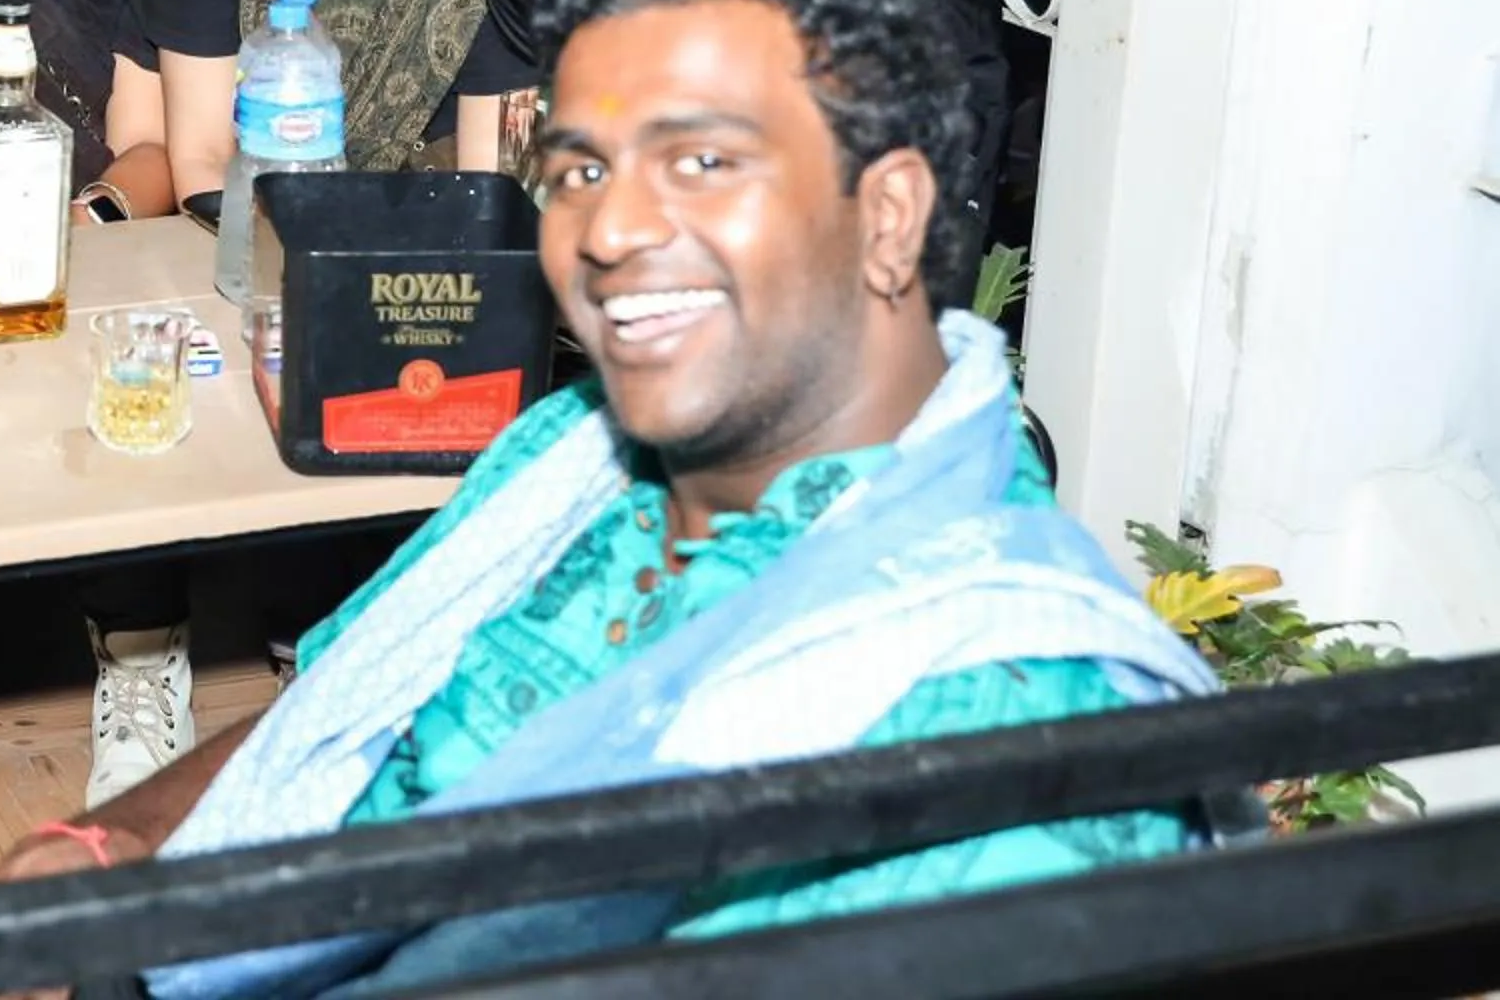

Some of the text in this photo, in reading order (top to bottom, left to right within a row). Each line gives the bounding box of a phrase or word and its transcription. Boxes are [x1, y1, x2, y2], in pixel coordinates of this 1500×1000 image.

[371, 273, 482, 304] ROYAL
[376, 306, 474, 322] TREASURE
[393, 331, 454, 346] WHISKY
